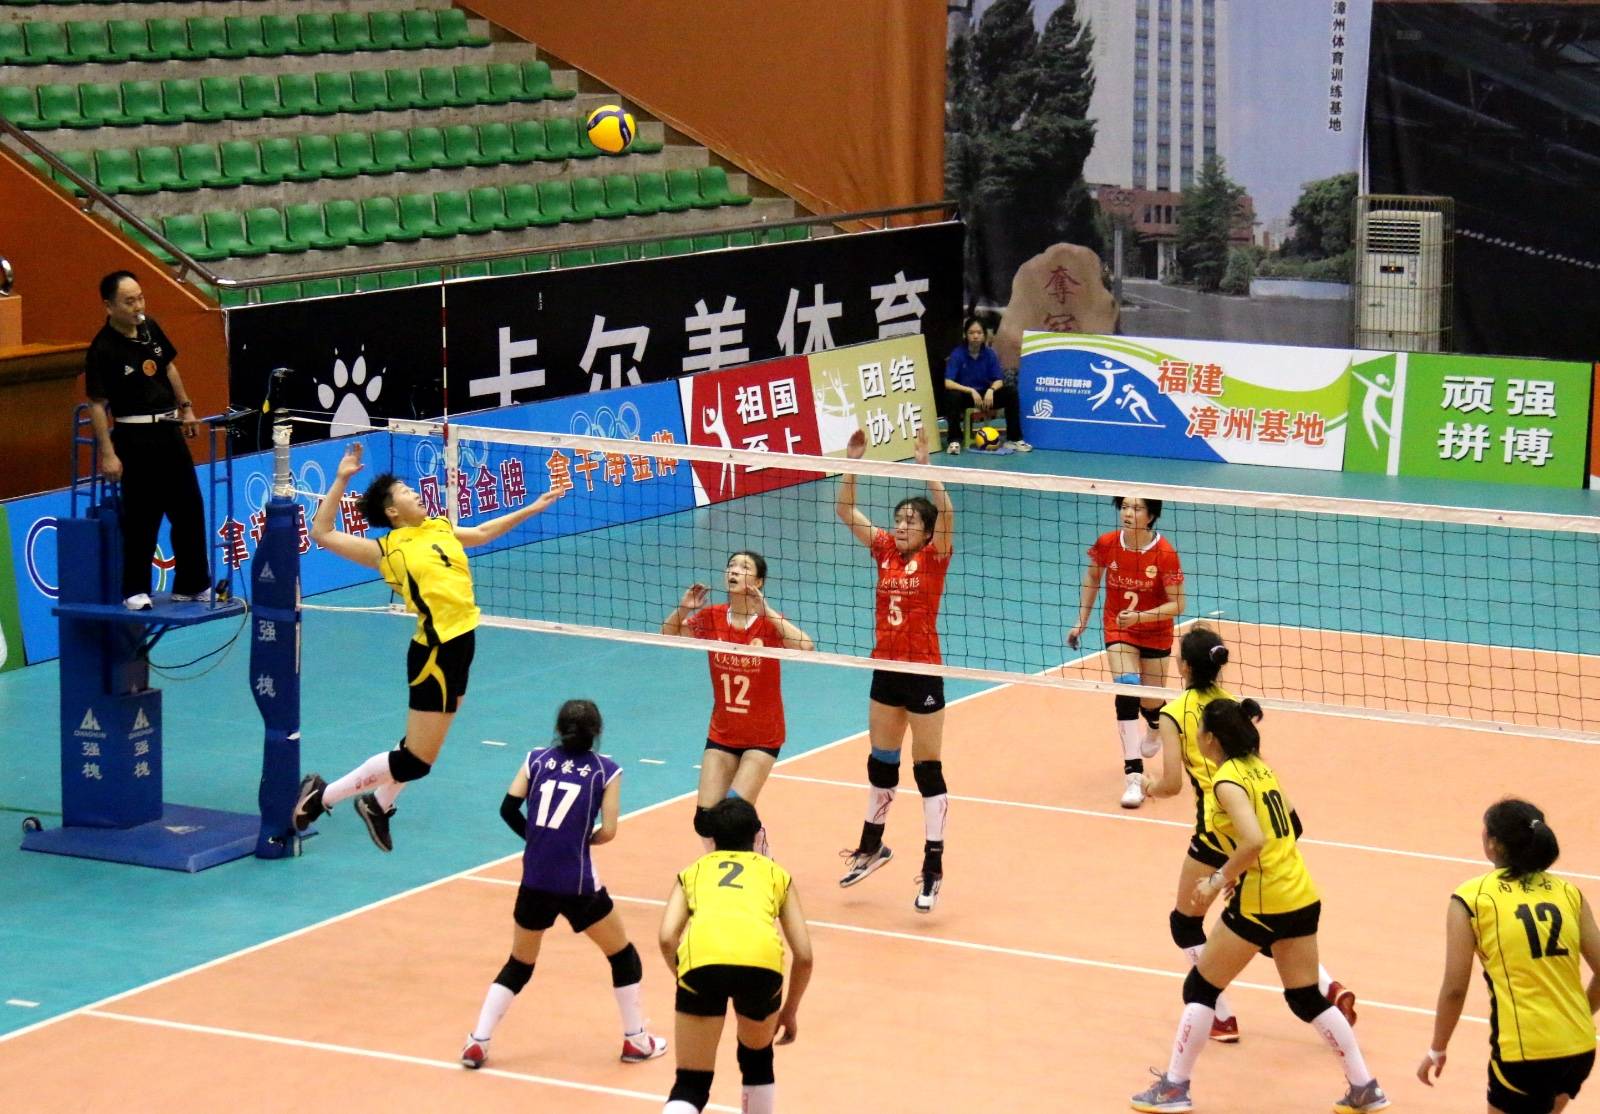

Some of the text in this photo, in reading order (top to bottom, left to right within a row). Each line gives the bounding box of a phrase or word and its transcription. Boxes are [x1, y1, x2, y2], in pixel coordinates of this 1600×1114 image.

[1328, 1, 1346, 132] 漳州体育训练基地
[469, 270, 930, 408] 卡尔美体育
[858, 355, 916, 401] 团结
[1157, 359, 1224, 397] 福建
[1441, 375, 1557, 418] 顽强
[735, 377, 799, 425] 祖国
[866, 401, 924, 447] 协作
[1185, 405, 1327, 447] 漳州基地
[431, 543, 452, 568] 1
[887, 595, 904, 627] 5
[720, 673, 751, 706] 12
[545, 757, 592, 778] 内蒙古
[535, 779, 582, 830] 17
[1262, 789, 1290, 839] 10
[718, 860, 745, 889] 2
[1514, 902, 1570, 959] 12
